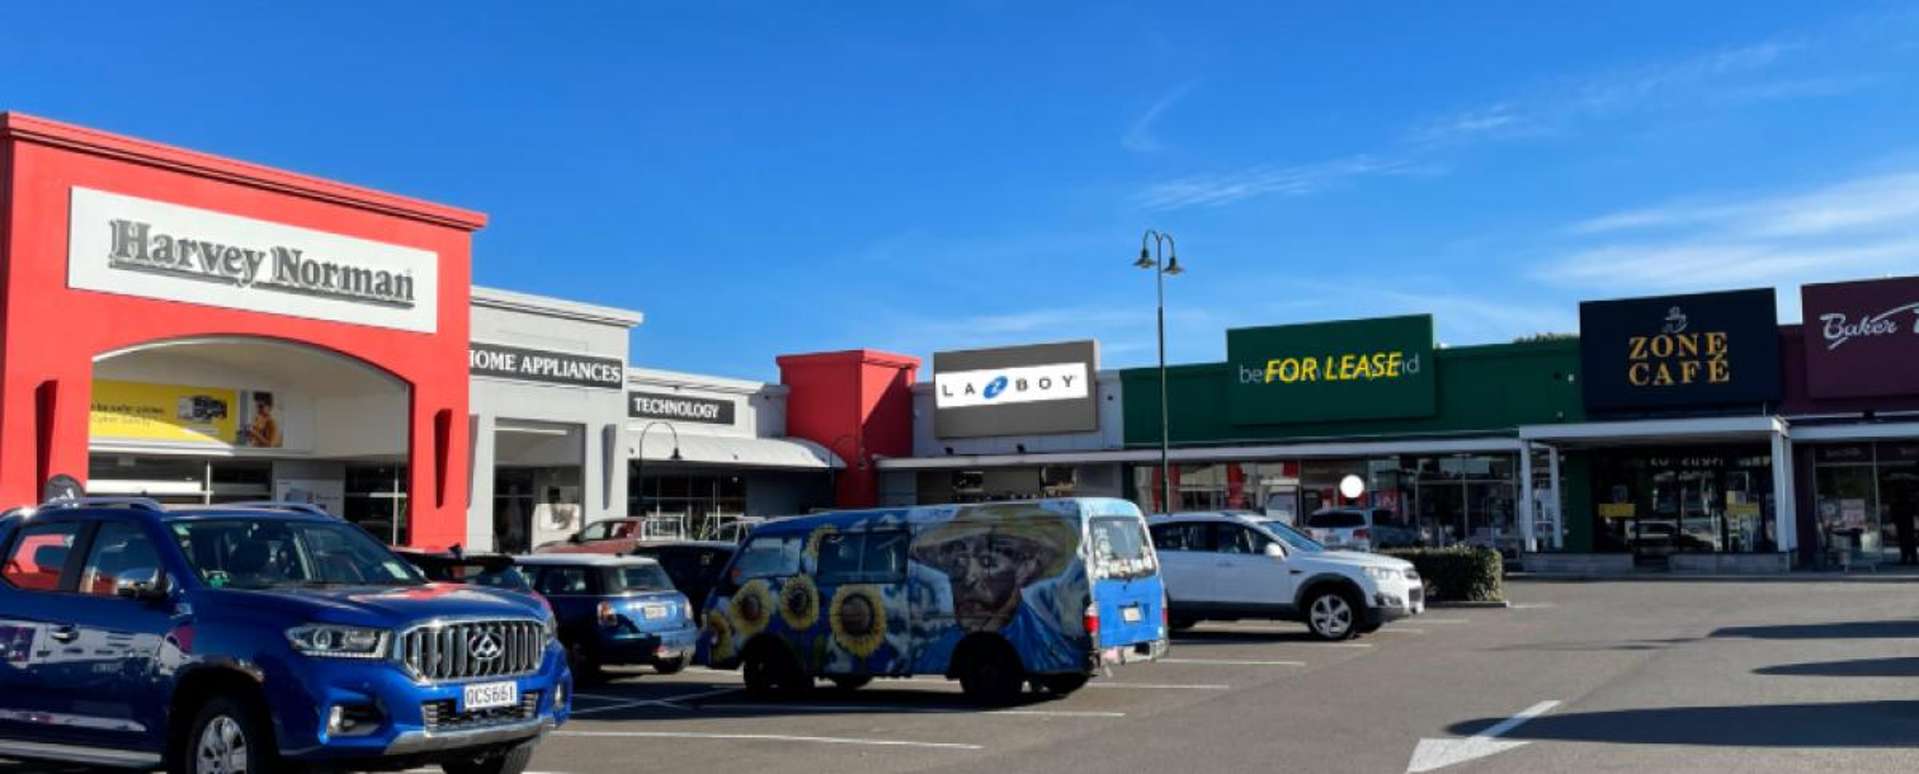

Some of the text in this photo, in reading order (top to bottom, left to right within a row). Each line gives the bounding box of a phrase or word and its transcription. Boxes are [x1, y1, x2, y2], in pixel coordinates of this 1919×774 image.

[108, 218, 415, 301] Harvey Norman
[1819, 312, 1898, 339] Baker
[1628, 331, 1728, 360] ZONE
[520, 355, 623, 384] APPLIANCES
[1628, 354, 1731, 386] CAFÉ
[633, 397, 719, 419] TECHNOLOGY
